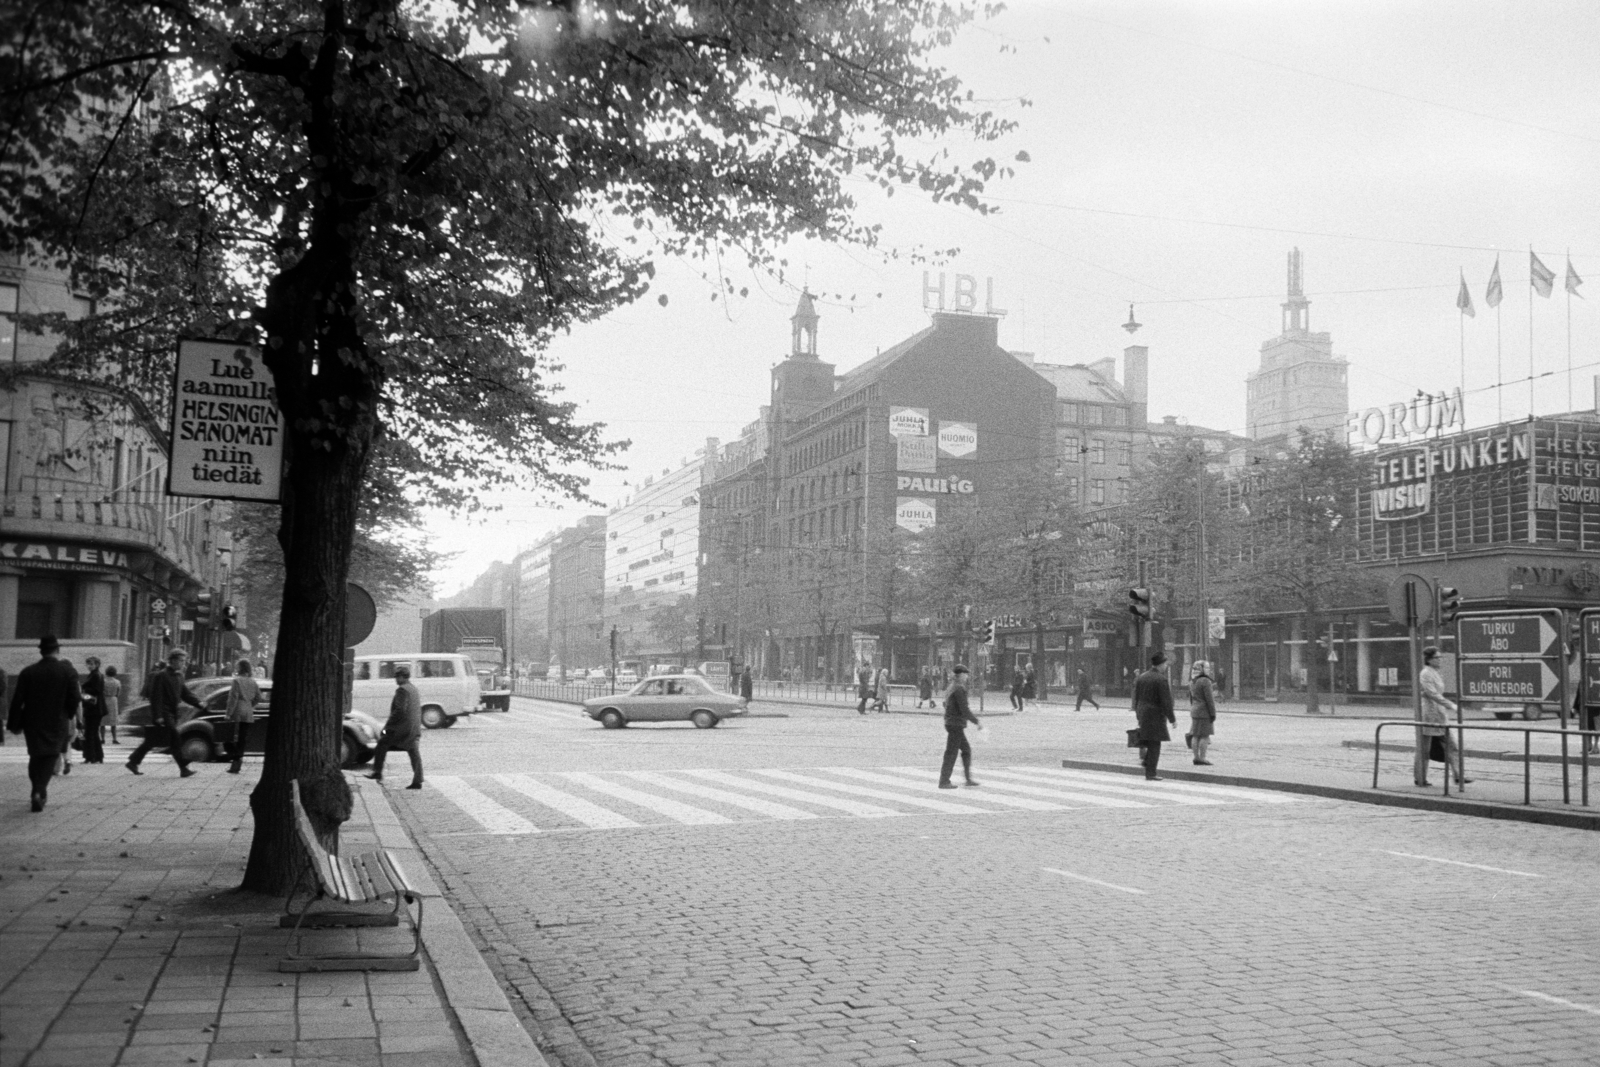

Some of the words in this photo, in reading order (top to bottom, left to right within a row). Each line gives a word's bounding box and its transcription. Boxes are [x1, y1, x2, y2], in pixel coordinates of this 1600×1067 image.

[922, 270, 1008, 315] HBL
[210, 359, 254, 380] Lue
[182, 400, 279, 426] HELSINGIN
[1343, 387, 1465, 448] FORUM
[180, 421, 279, 447] SANOMAT
[941, 433, 975, 444] HUOMIO
[202, 445, 253, 465] niin
[1375, 433, 1529, 485] TELEFUNKEN
[191, 463, 262, 486] tiedät
[1377, 483, 1427, 511] VISIO
[899, 510, 933, 519] JUHLA
[1087, 621, 1117, 631] ASKO
[1482, 622, 1515, 635] TURKU
[1490, 636, 1509, 650] ÅBO
[1489, 666, 1512, 679] PORI
[1469, 681, 1534, 695] BJÖRNEBORG
